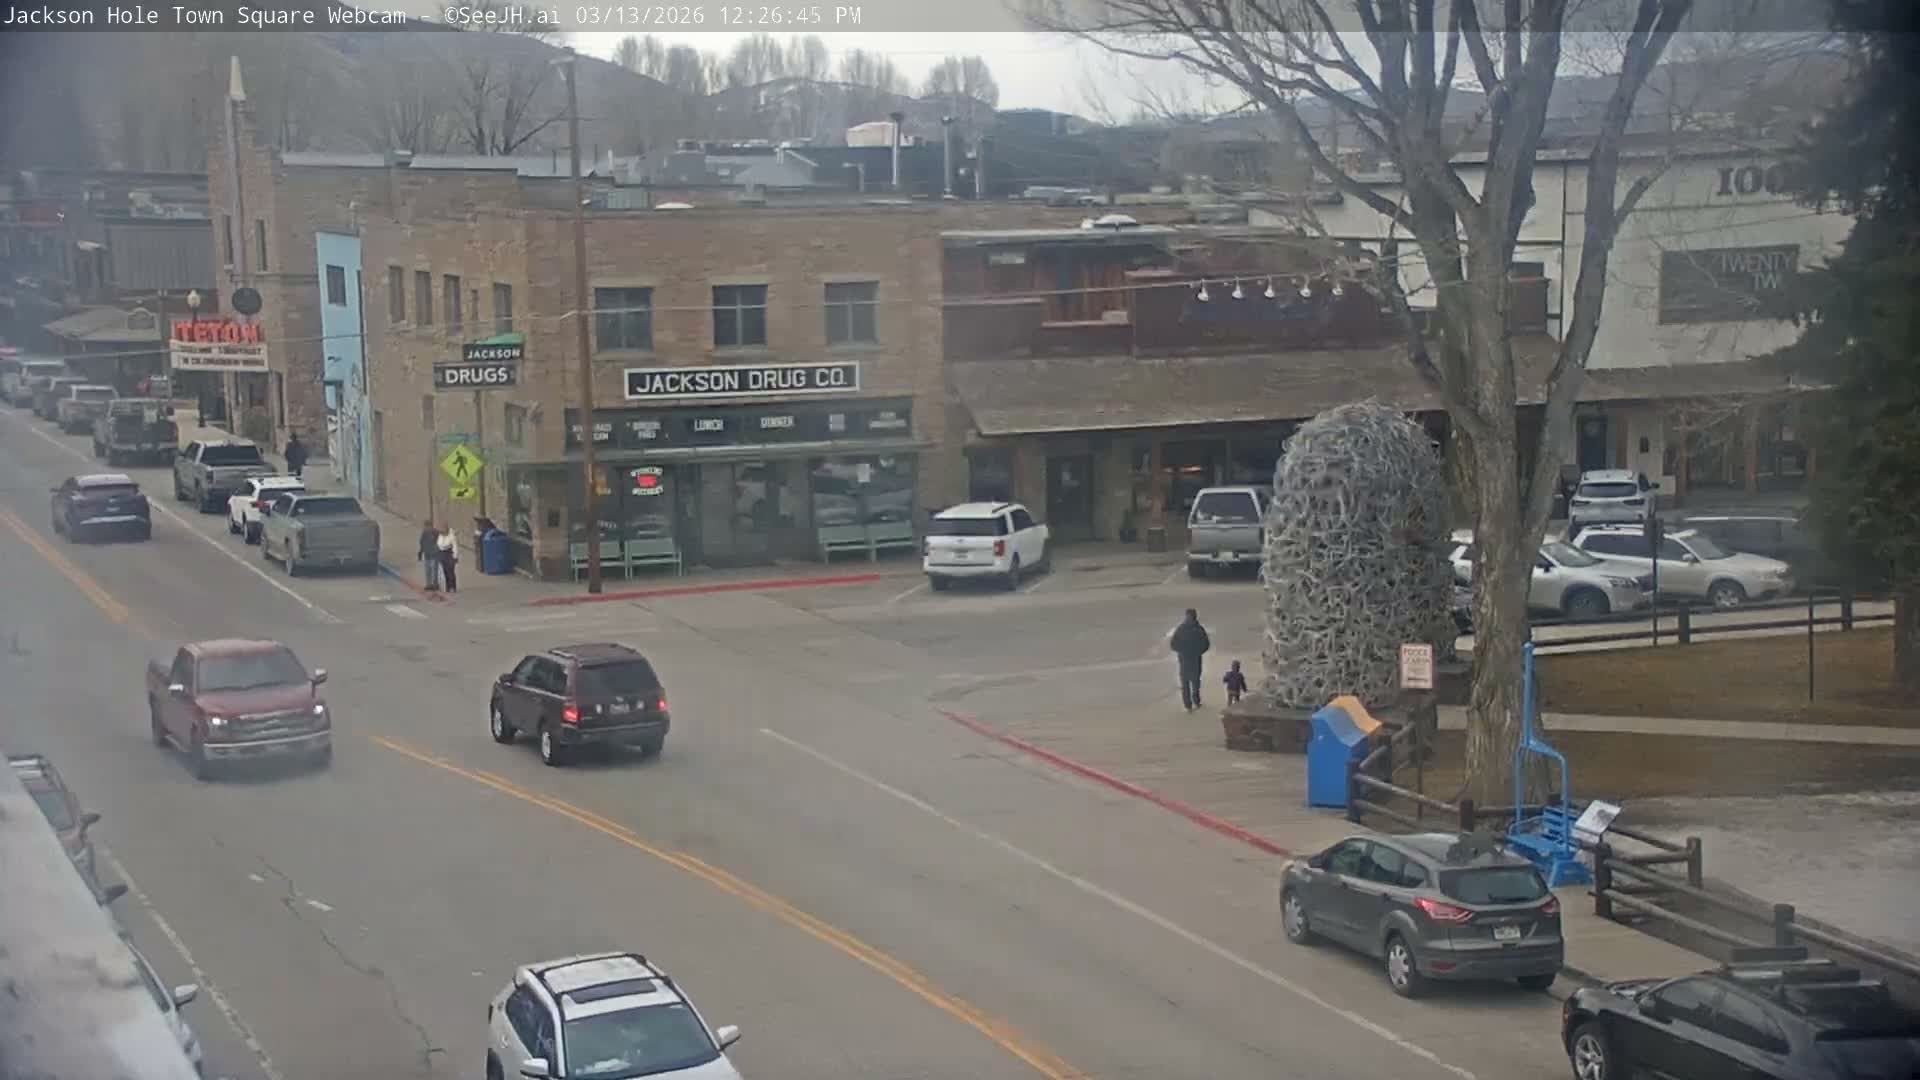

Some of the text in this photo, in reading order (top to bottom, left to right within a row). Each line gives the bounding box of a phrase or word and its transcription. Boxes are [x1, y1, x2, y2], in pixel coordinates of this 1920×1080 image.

[1719, 252, 1793, 273] TWENTY
[1752, 271, 1785, 289] TW
[177, 322, 257, 344] TETON
[467, 349, 520, 359] JACKSON
[445, 367, 508, 384] DRUGS
[636, 367, 847, 393] JACKSON DRUG CO.
